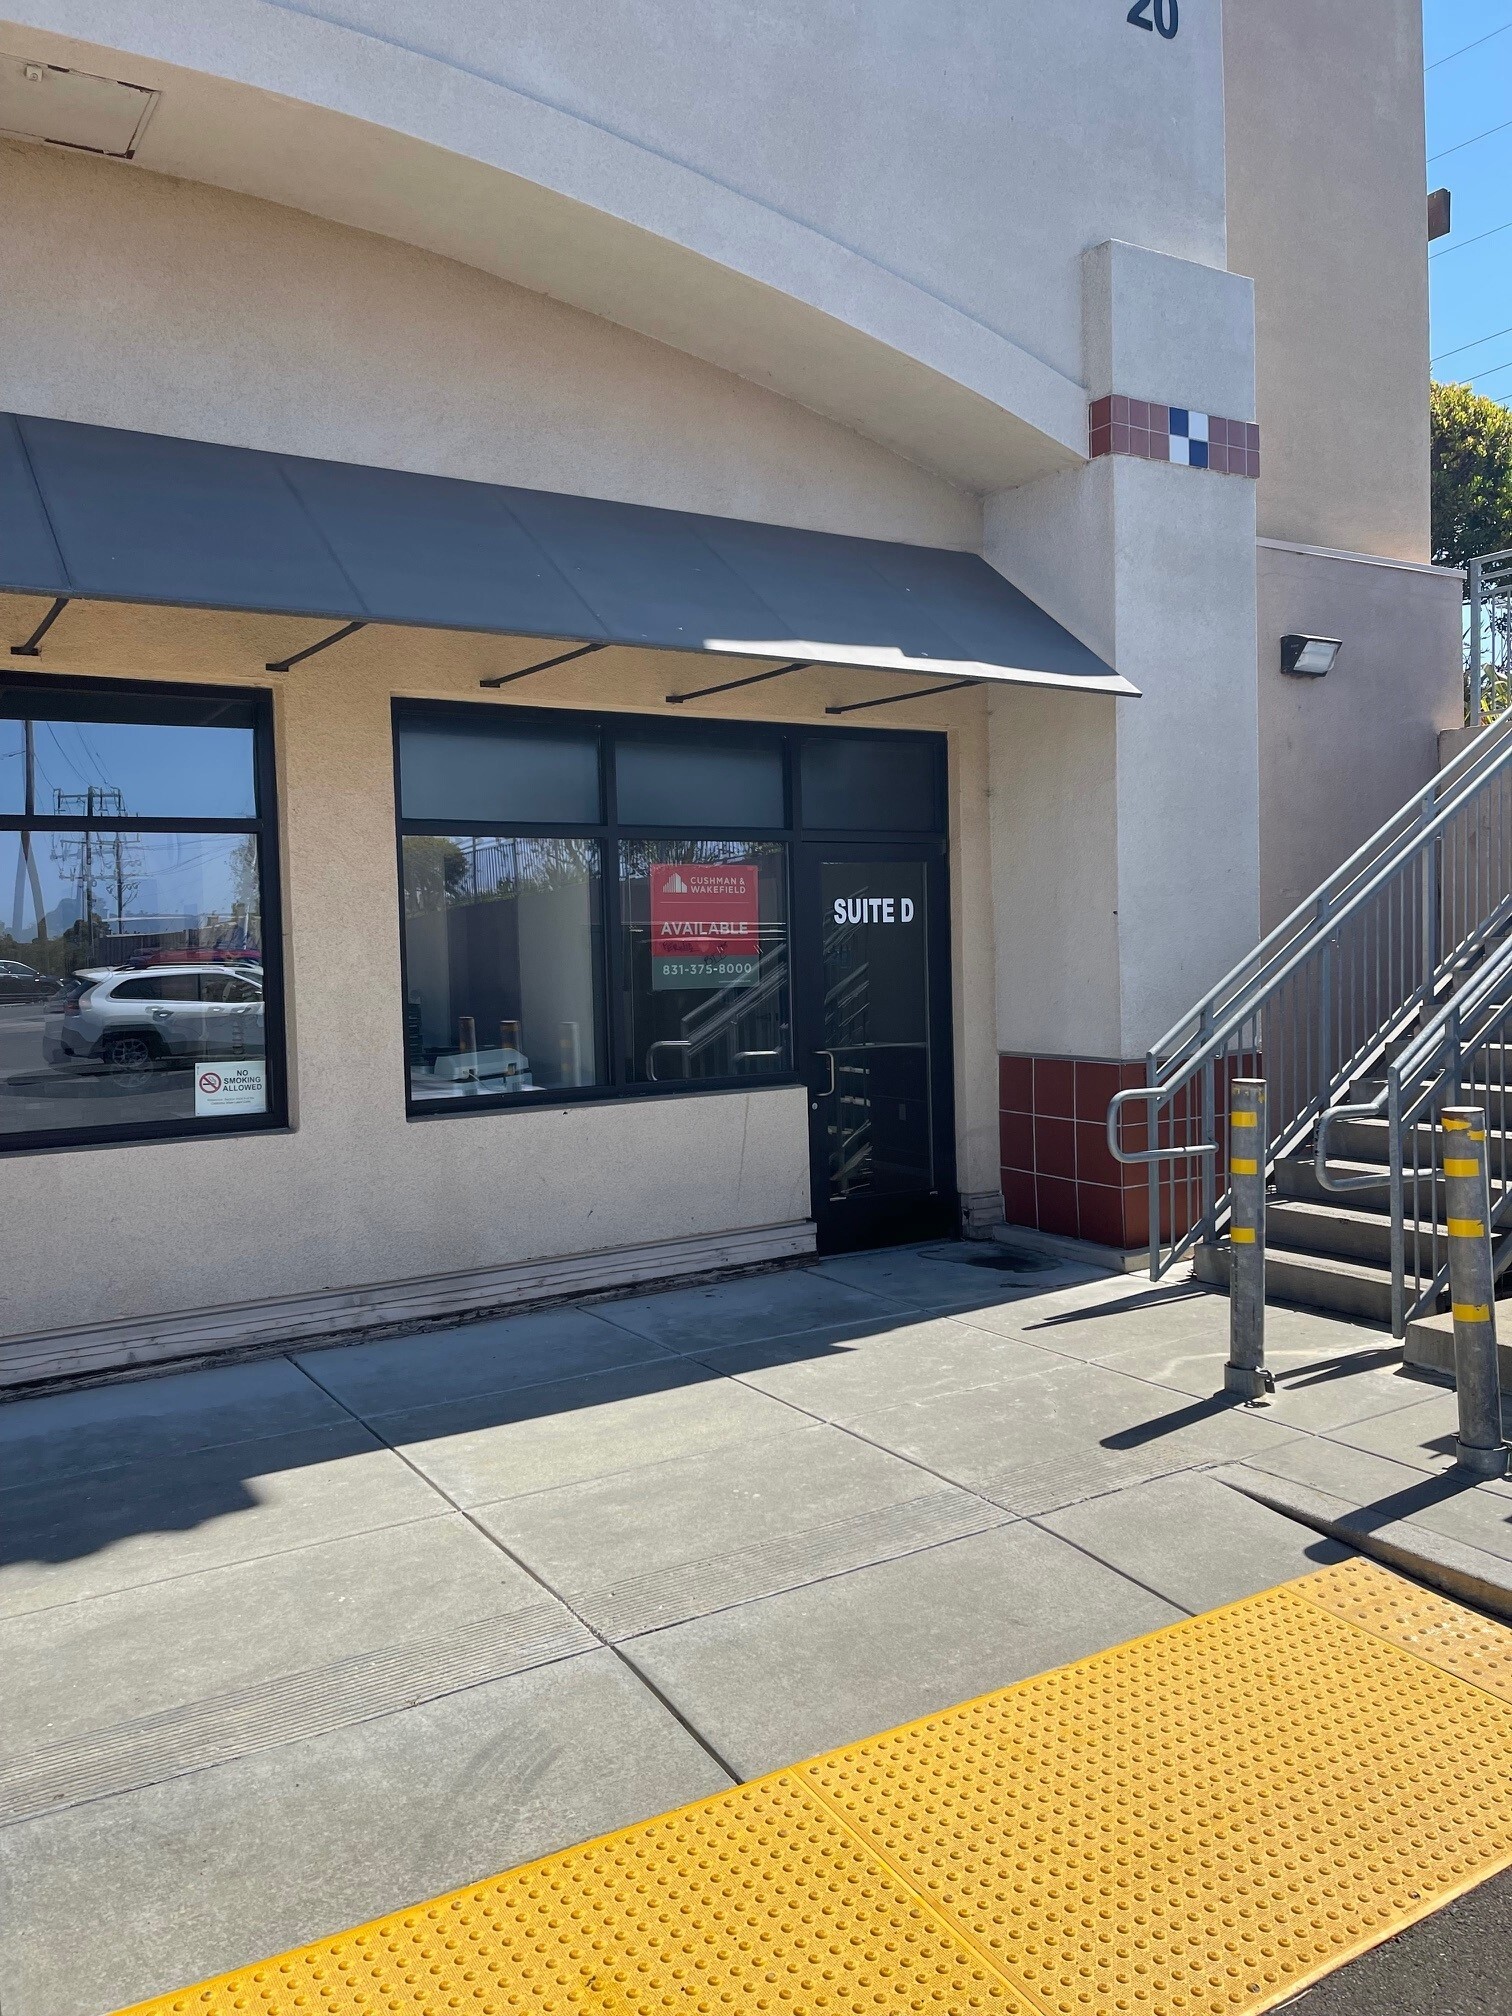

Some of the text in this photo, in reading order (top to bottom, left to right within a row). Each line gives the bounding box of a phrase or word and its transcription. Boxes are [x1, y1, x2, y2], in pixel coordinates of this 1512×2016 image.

[1126, 0, 1179, 39] 20
[690, 876, 746, 886] CUSHMAN &
[690, 885, 746, 894] WAKEFIELD
[833, 898, 914, 924] SUITE D
[661, 921, 749, 936] AVAILABLE
[662, 963, 752, 976] 831-375-8000
[236, 1069, 249, 1077] NO
[223, 1076, 261, 1085] SMOKING
[222, 1083, 263, 1092] ALLOWED
